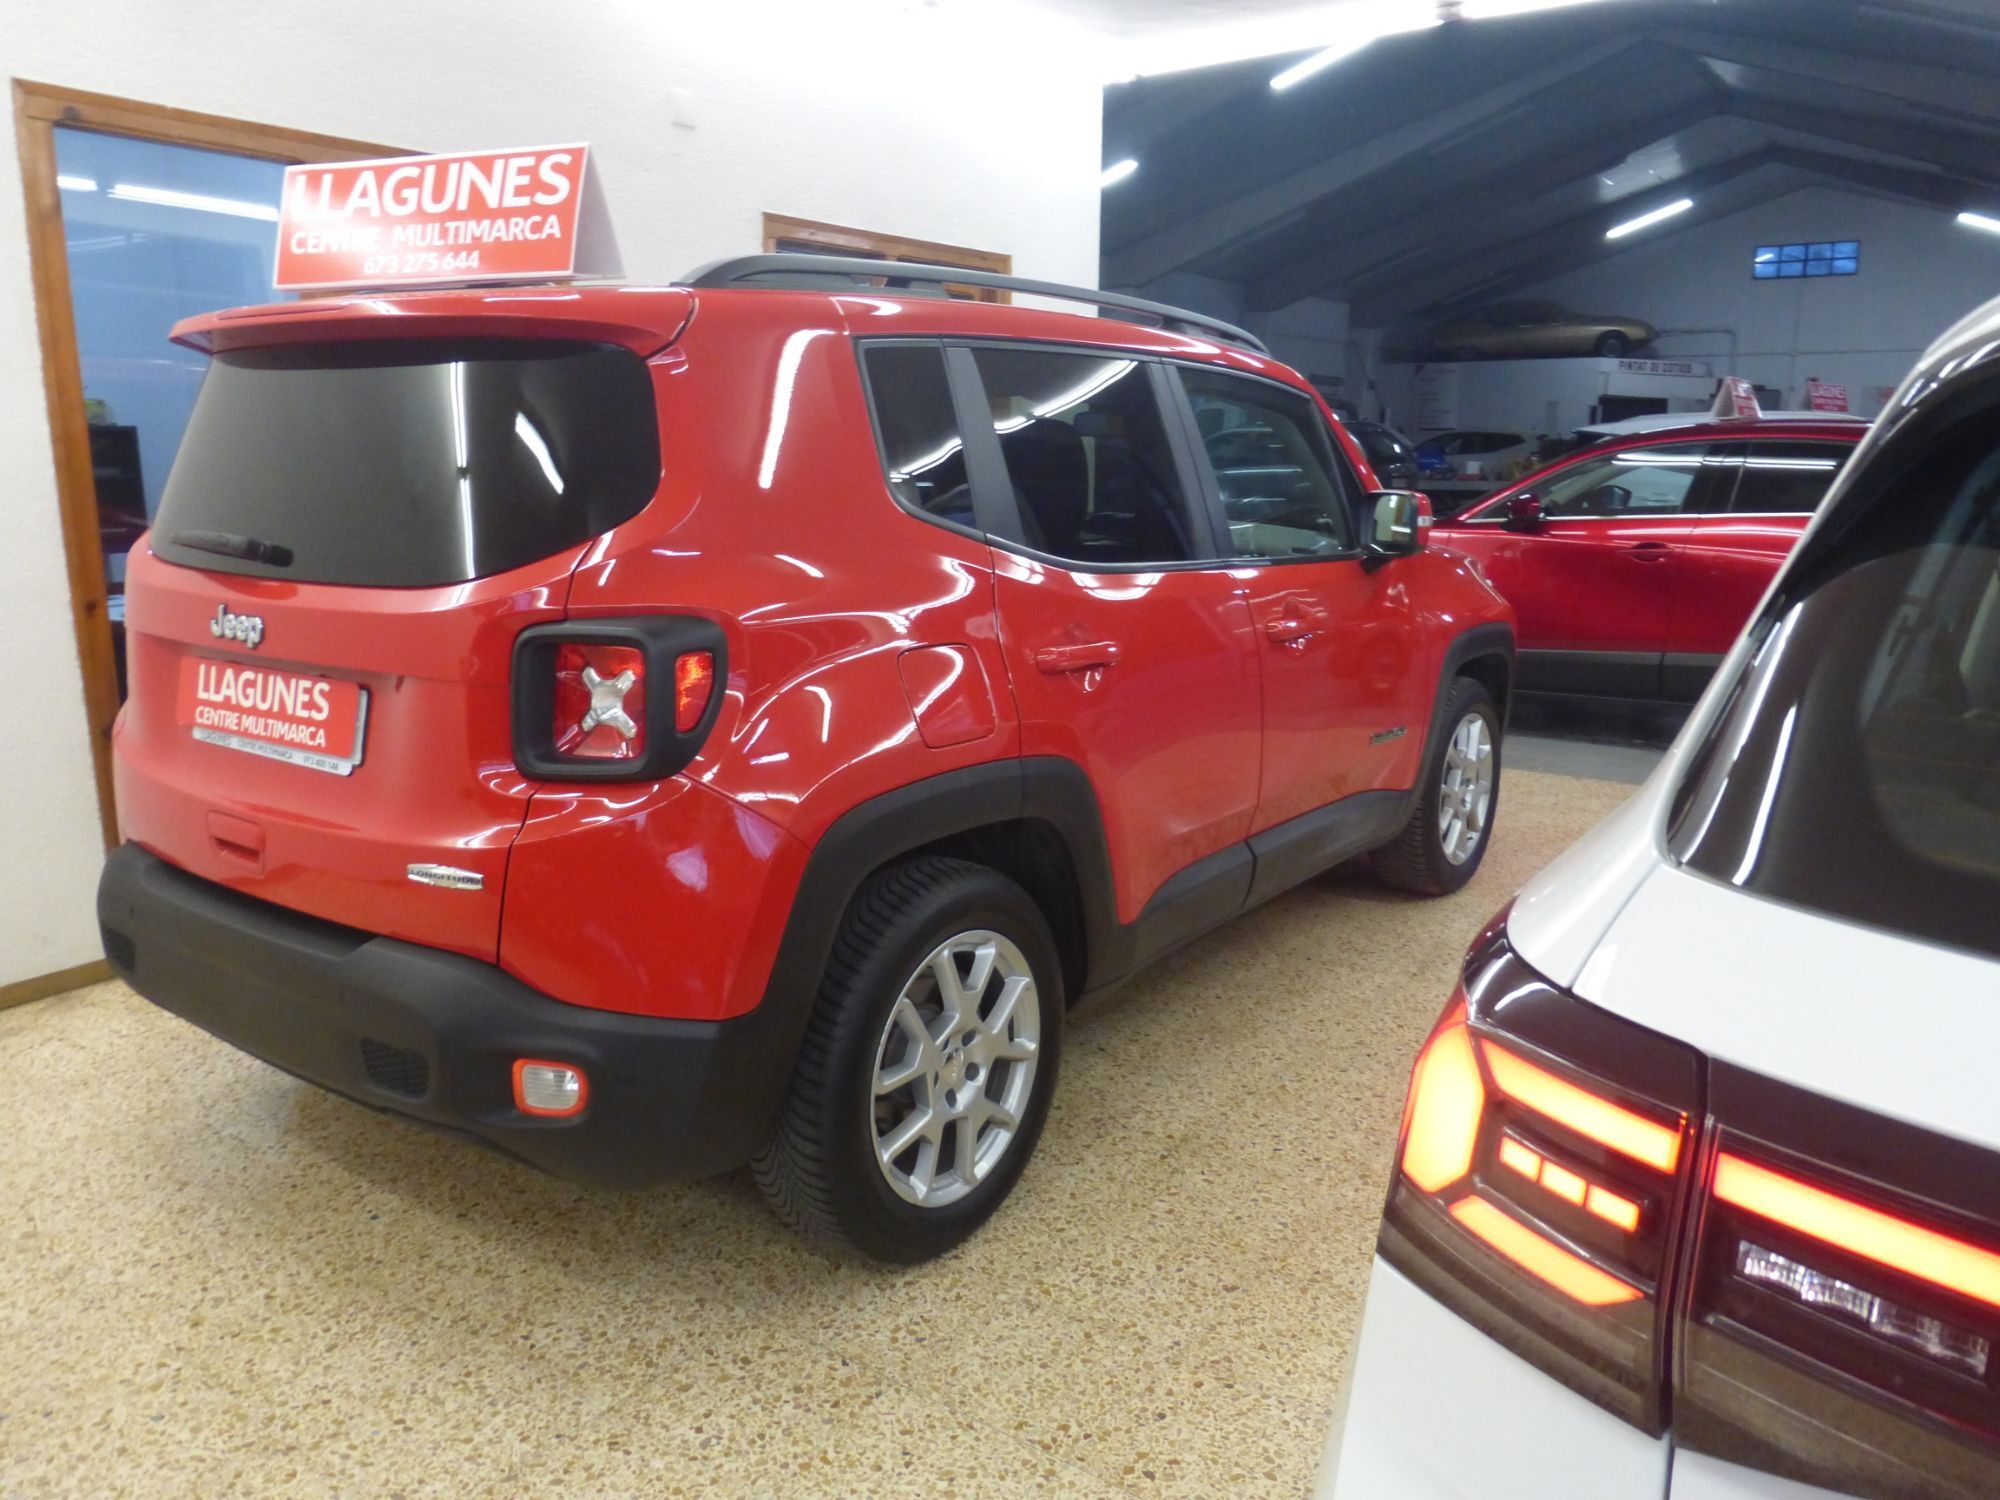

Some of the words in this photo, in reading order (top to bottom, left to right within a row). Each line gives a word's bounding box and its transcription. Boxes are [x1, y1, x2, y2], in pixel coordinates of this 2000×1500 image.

[290, 153, 572, 222] LLAGUNES
[290, 226, 382, 255] CENTRE
[391, 214, 561, 249] MULTIMARCA
[364, 254, 398, 275] 673
[403, 252, 438, 273] 275
[443, 250, 480, 270] 644
[211, 604, 264, 648] Jeep
[196, 663, 331, 721] LLAGUNES
[195, 705, 239, 731] CENTRE
[240, 712, 326, 748] MULTIMARCA
